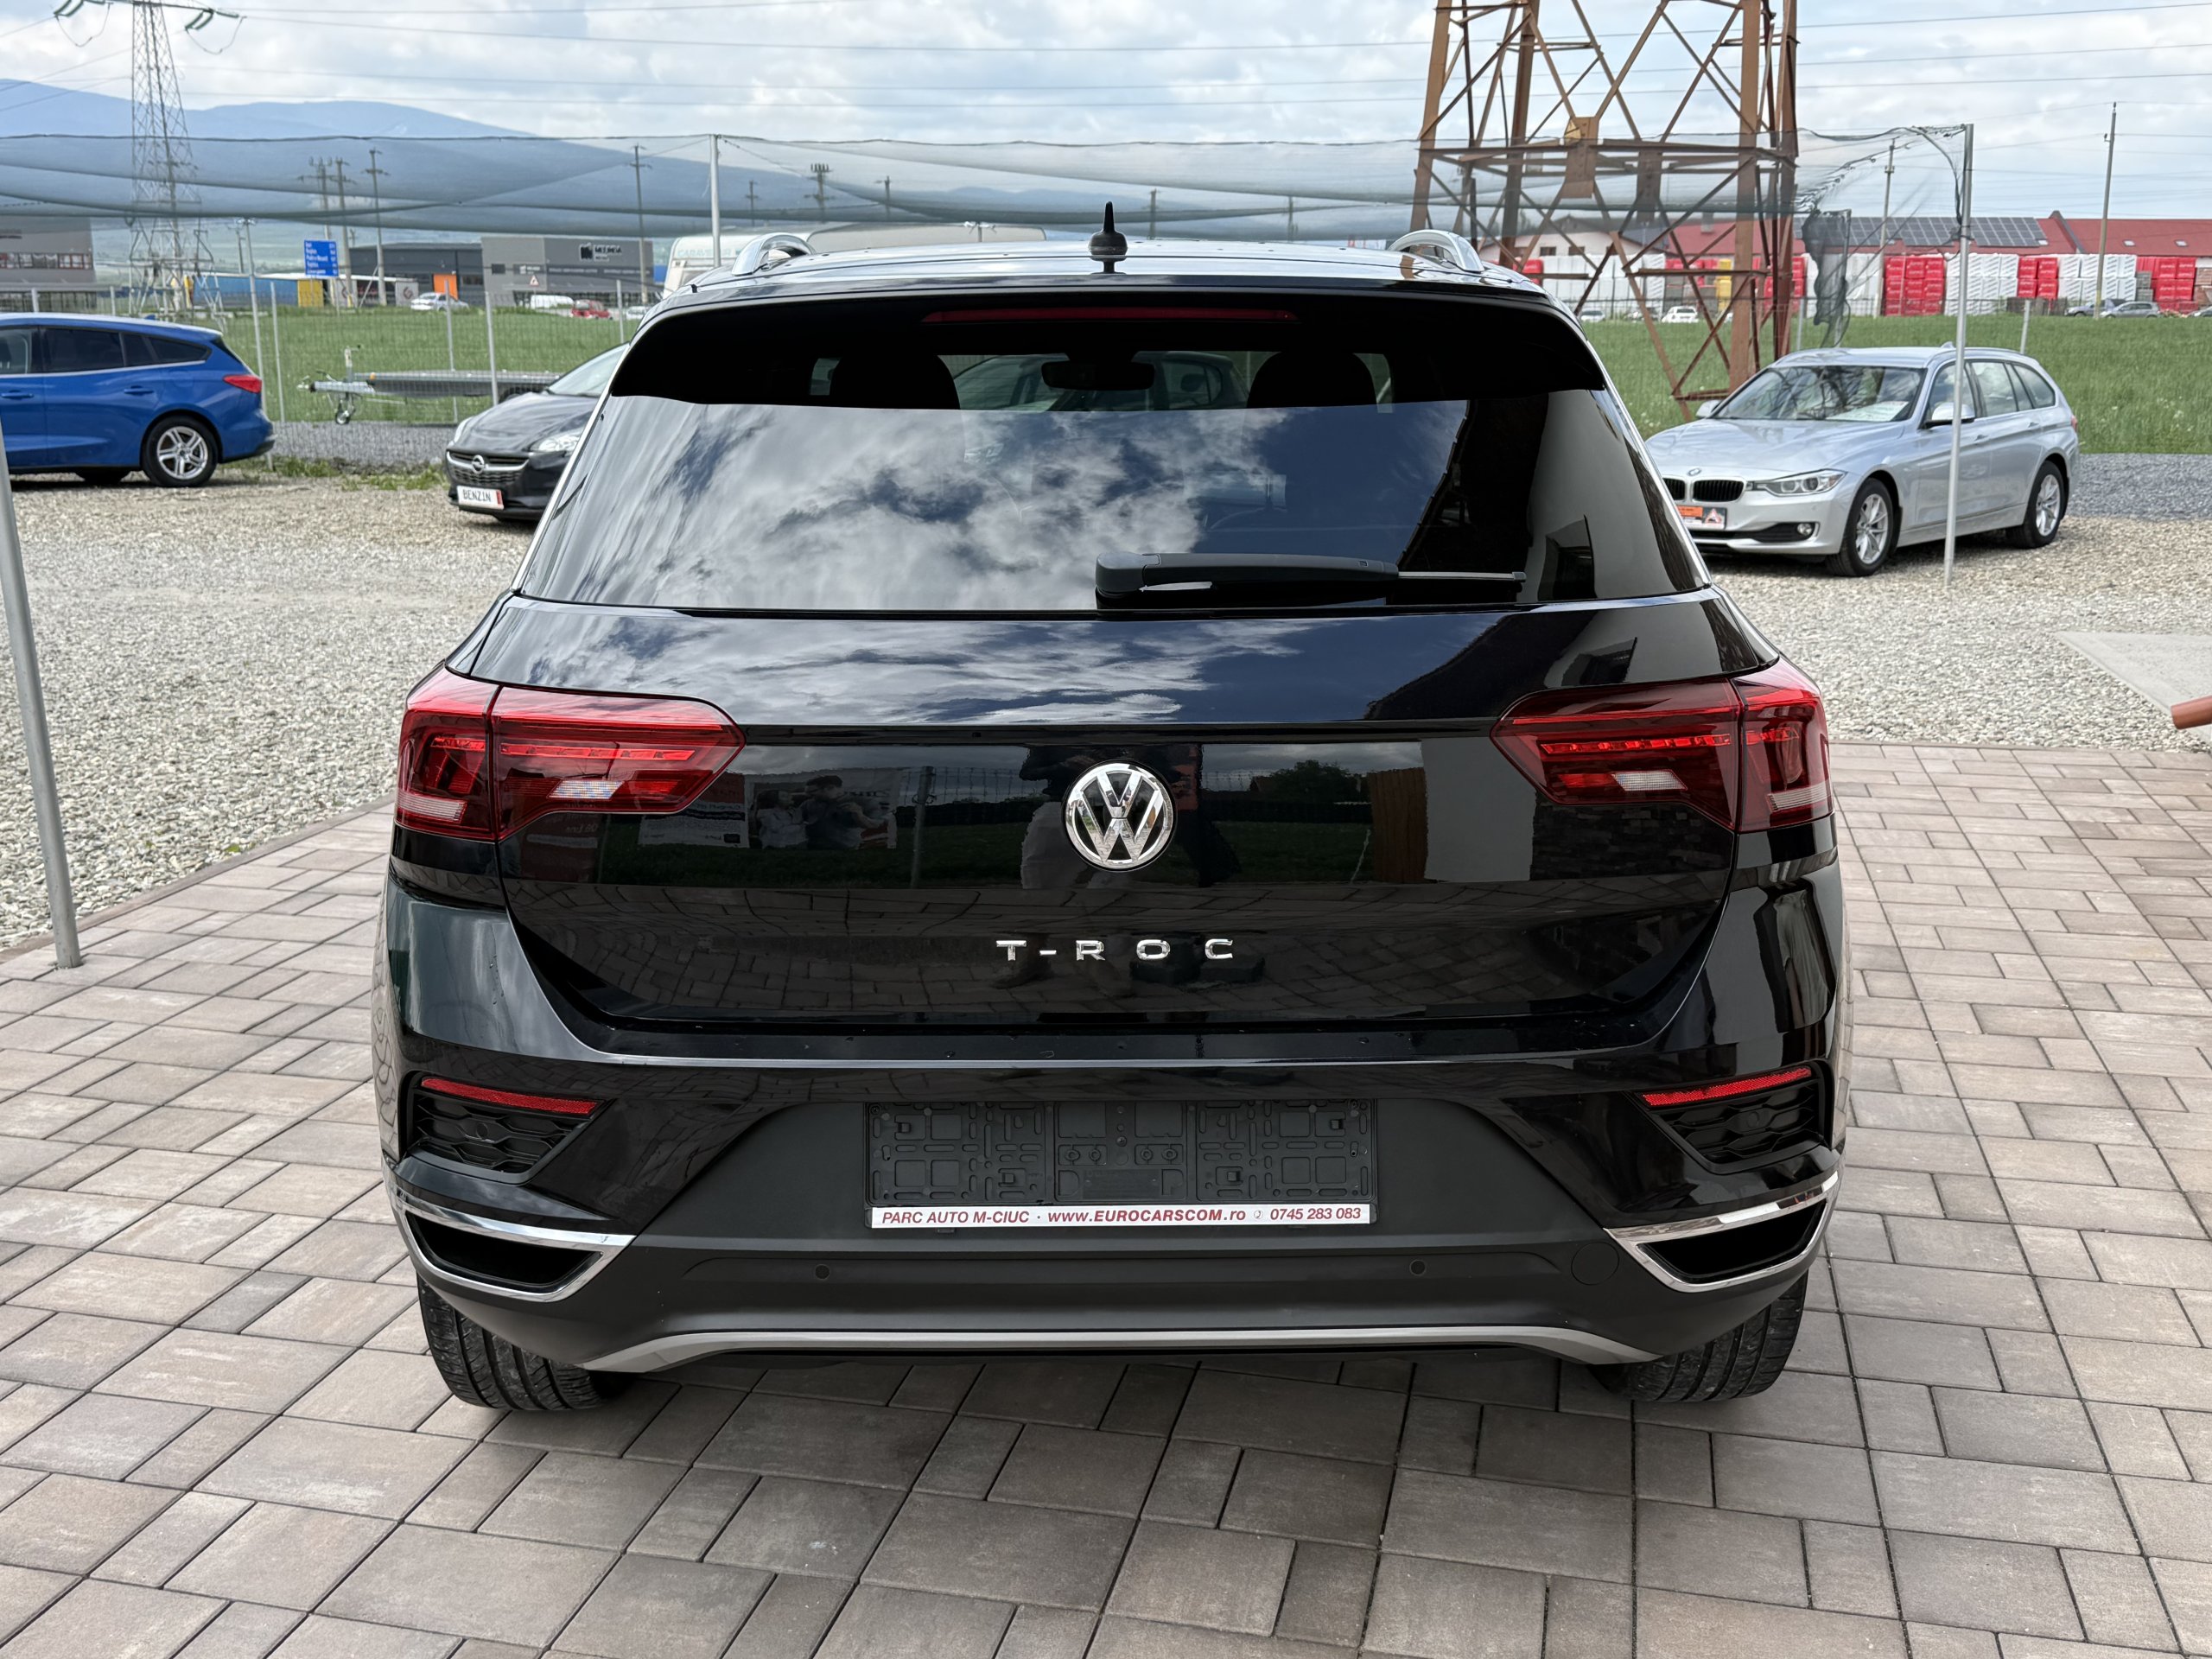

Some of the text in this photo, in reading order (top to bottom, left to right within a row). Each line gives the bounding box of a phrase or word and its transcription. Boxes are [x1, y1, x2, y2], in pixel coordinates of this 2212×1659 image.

[462, 489, 492, 502] BENZIN
[881, 1206, 1362, 1224] PARC AUTO M-CIUC www.EUROCARSCOM.ro 0745 283 083
